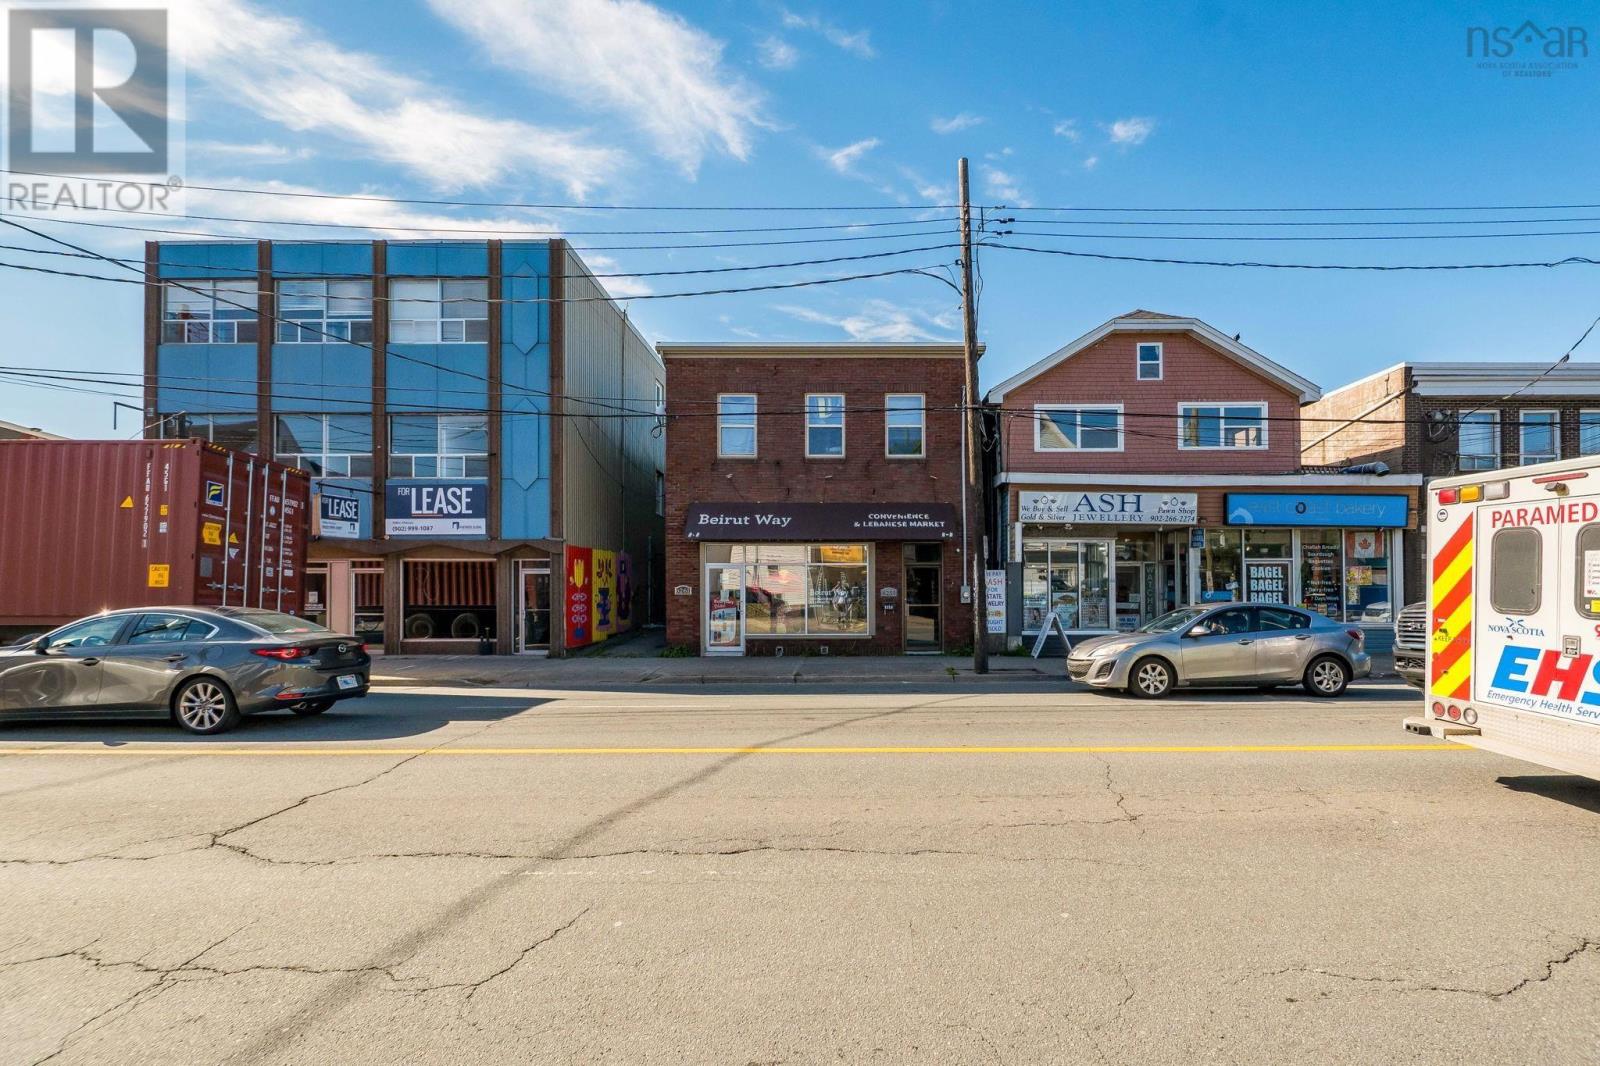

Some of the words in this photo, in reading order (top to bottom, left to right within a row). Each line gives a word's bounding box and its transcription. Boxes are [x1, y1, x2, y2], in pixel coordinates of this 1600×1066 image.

[397, 487, 410, 496] FOR
[411, 487, 473, 514] LEASE
[1072, 493, 1144, 513] ASH
[329, 498, 358, 519] LEASE
[1033, 505, 1045, 513] Buy
[698, 513, 750, 525] Beirut
[754, 514, 792, 528] Way
[1072, 513, 1144, 521] JEWELLERY
[1491, 502, 1600, 528] PARAMED
[1250, 566, 1284, 578] BAGEL
[987, 578, 1003, 586] ASH
[1250, 579, 1284, 591] BAGEL
[986, 592, 1003, 600] STATE
[1250, 592, 1284, 603] BAGEL
[1488, 624, 1510, 634] NOVA
[1511, 628, 1546, 637] SCOTIA
[1487, 690, 1537, 708] Emergency
[1544, 700, 1576, 713] Health
